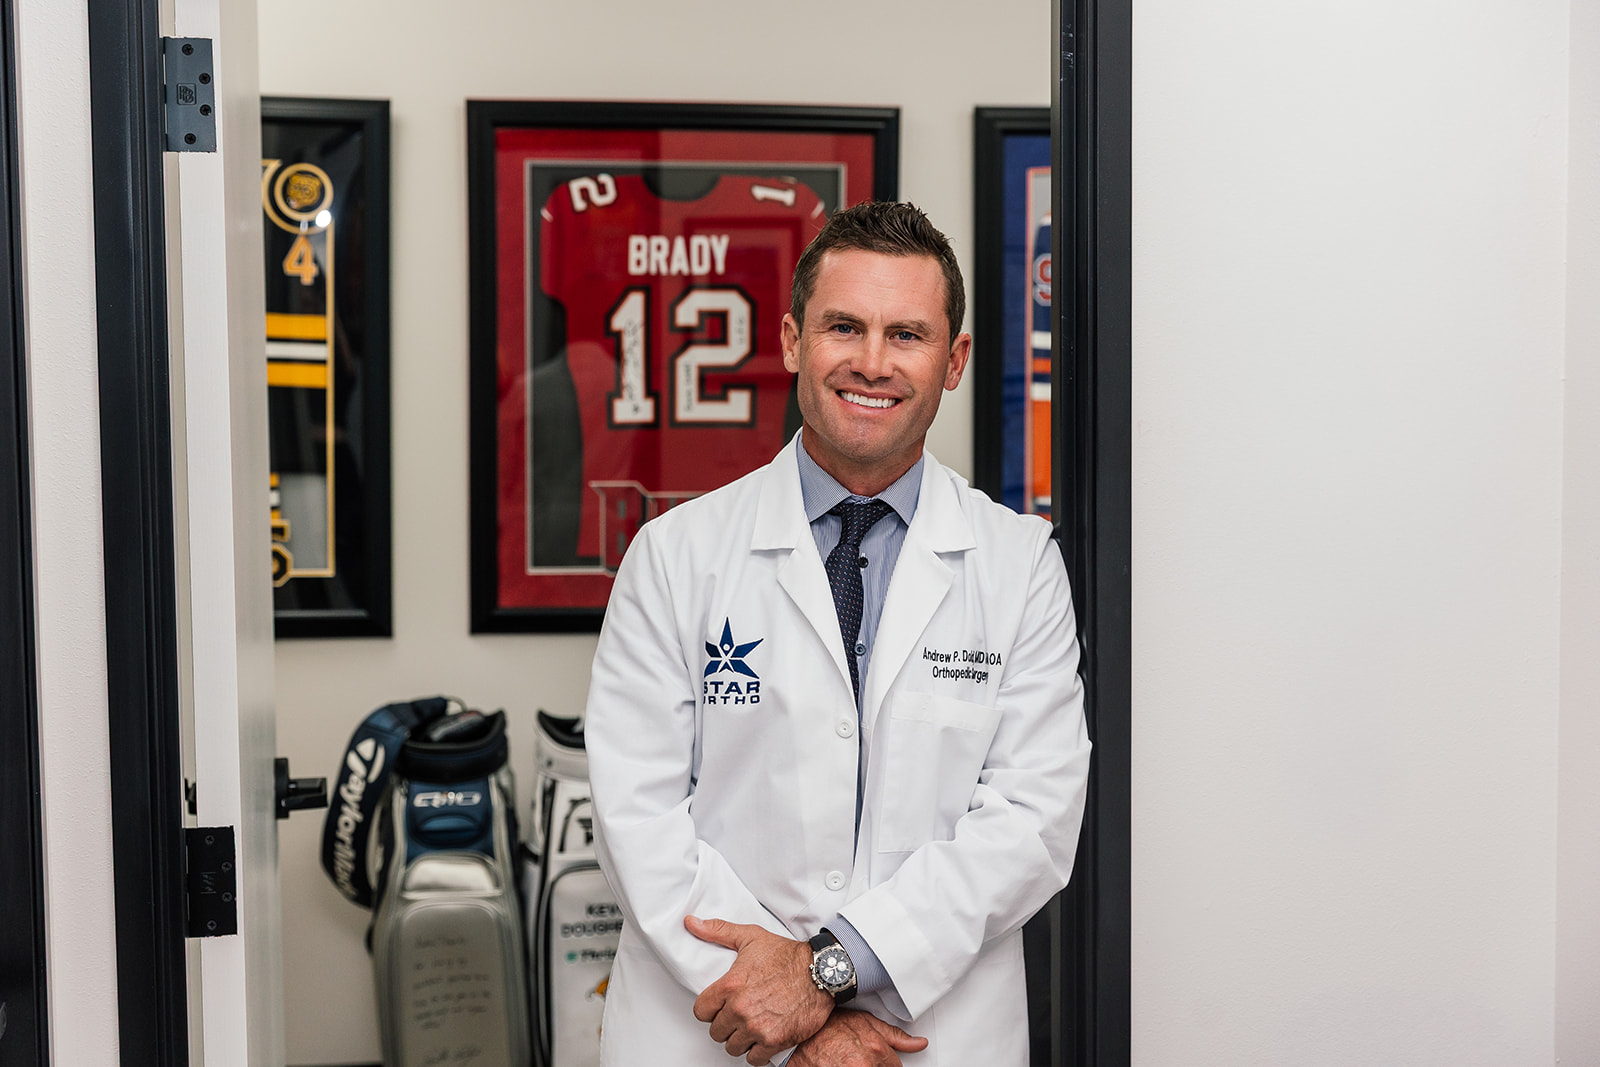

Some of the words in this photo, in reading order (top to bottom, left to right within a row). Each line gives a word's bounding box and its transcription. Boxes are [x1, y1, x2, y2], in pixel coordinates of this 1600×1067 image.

[283, 234, 320, 286] 4
[628, 235, 730, 276] BRADY
[606, 286, 756, 428] 12
[922, 646, 952, 663] Andrew
[953, 650, 961, 662] P.
[703, 695, 760, 705] RTHO
